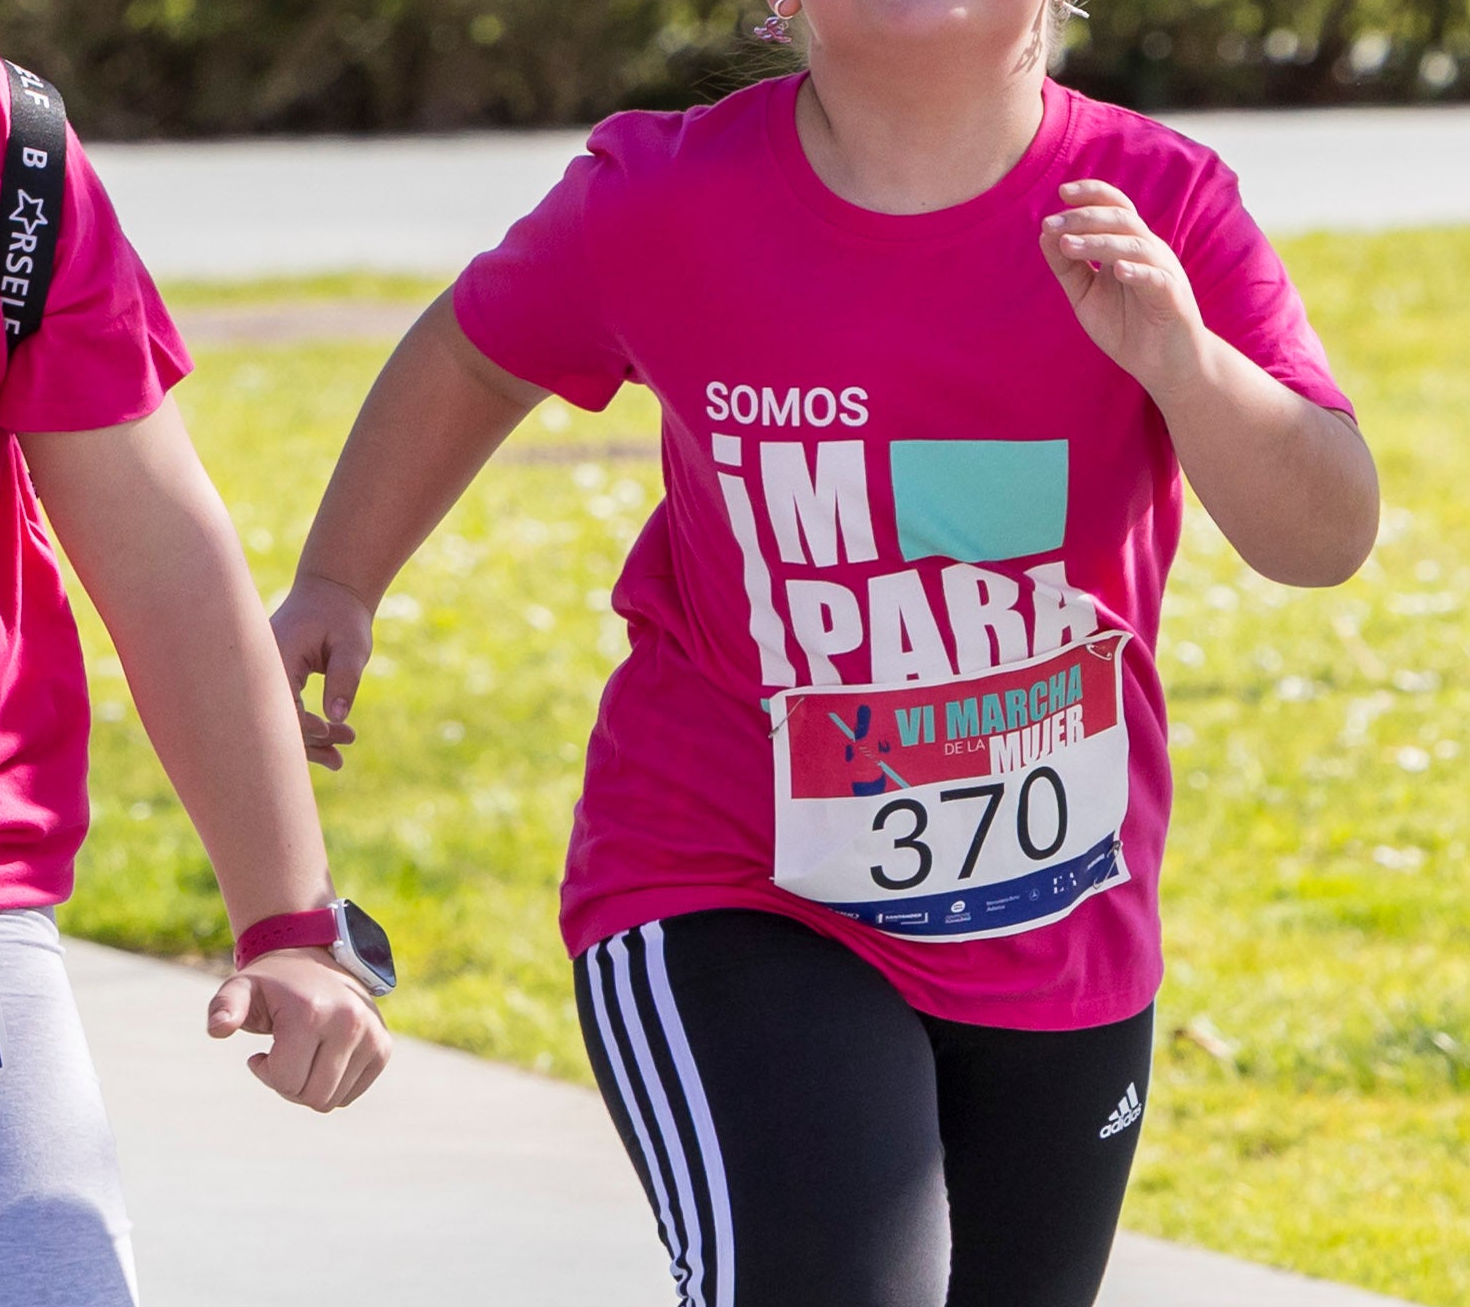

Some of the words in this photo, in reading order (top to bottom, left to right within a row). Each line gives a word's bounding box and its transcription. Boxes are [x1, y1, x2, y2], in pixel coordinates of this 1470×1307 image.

[705, 381, 870, 427] SOMOS
[786, 560, 1099, 686] PARA
[896, 704, 935, 747] VI
[945, 664, 1084, 740] MARCHA
[944, 741, 963, 756] DE
[967, 738, 986, 753] LA
[989, 703, 1085, 775] MUJER
[869, 766, 1069, 891] 370
[1099, 1106, 1143, 1139] adidas
